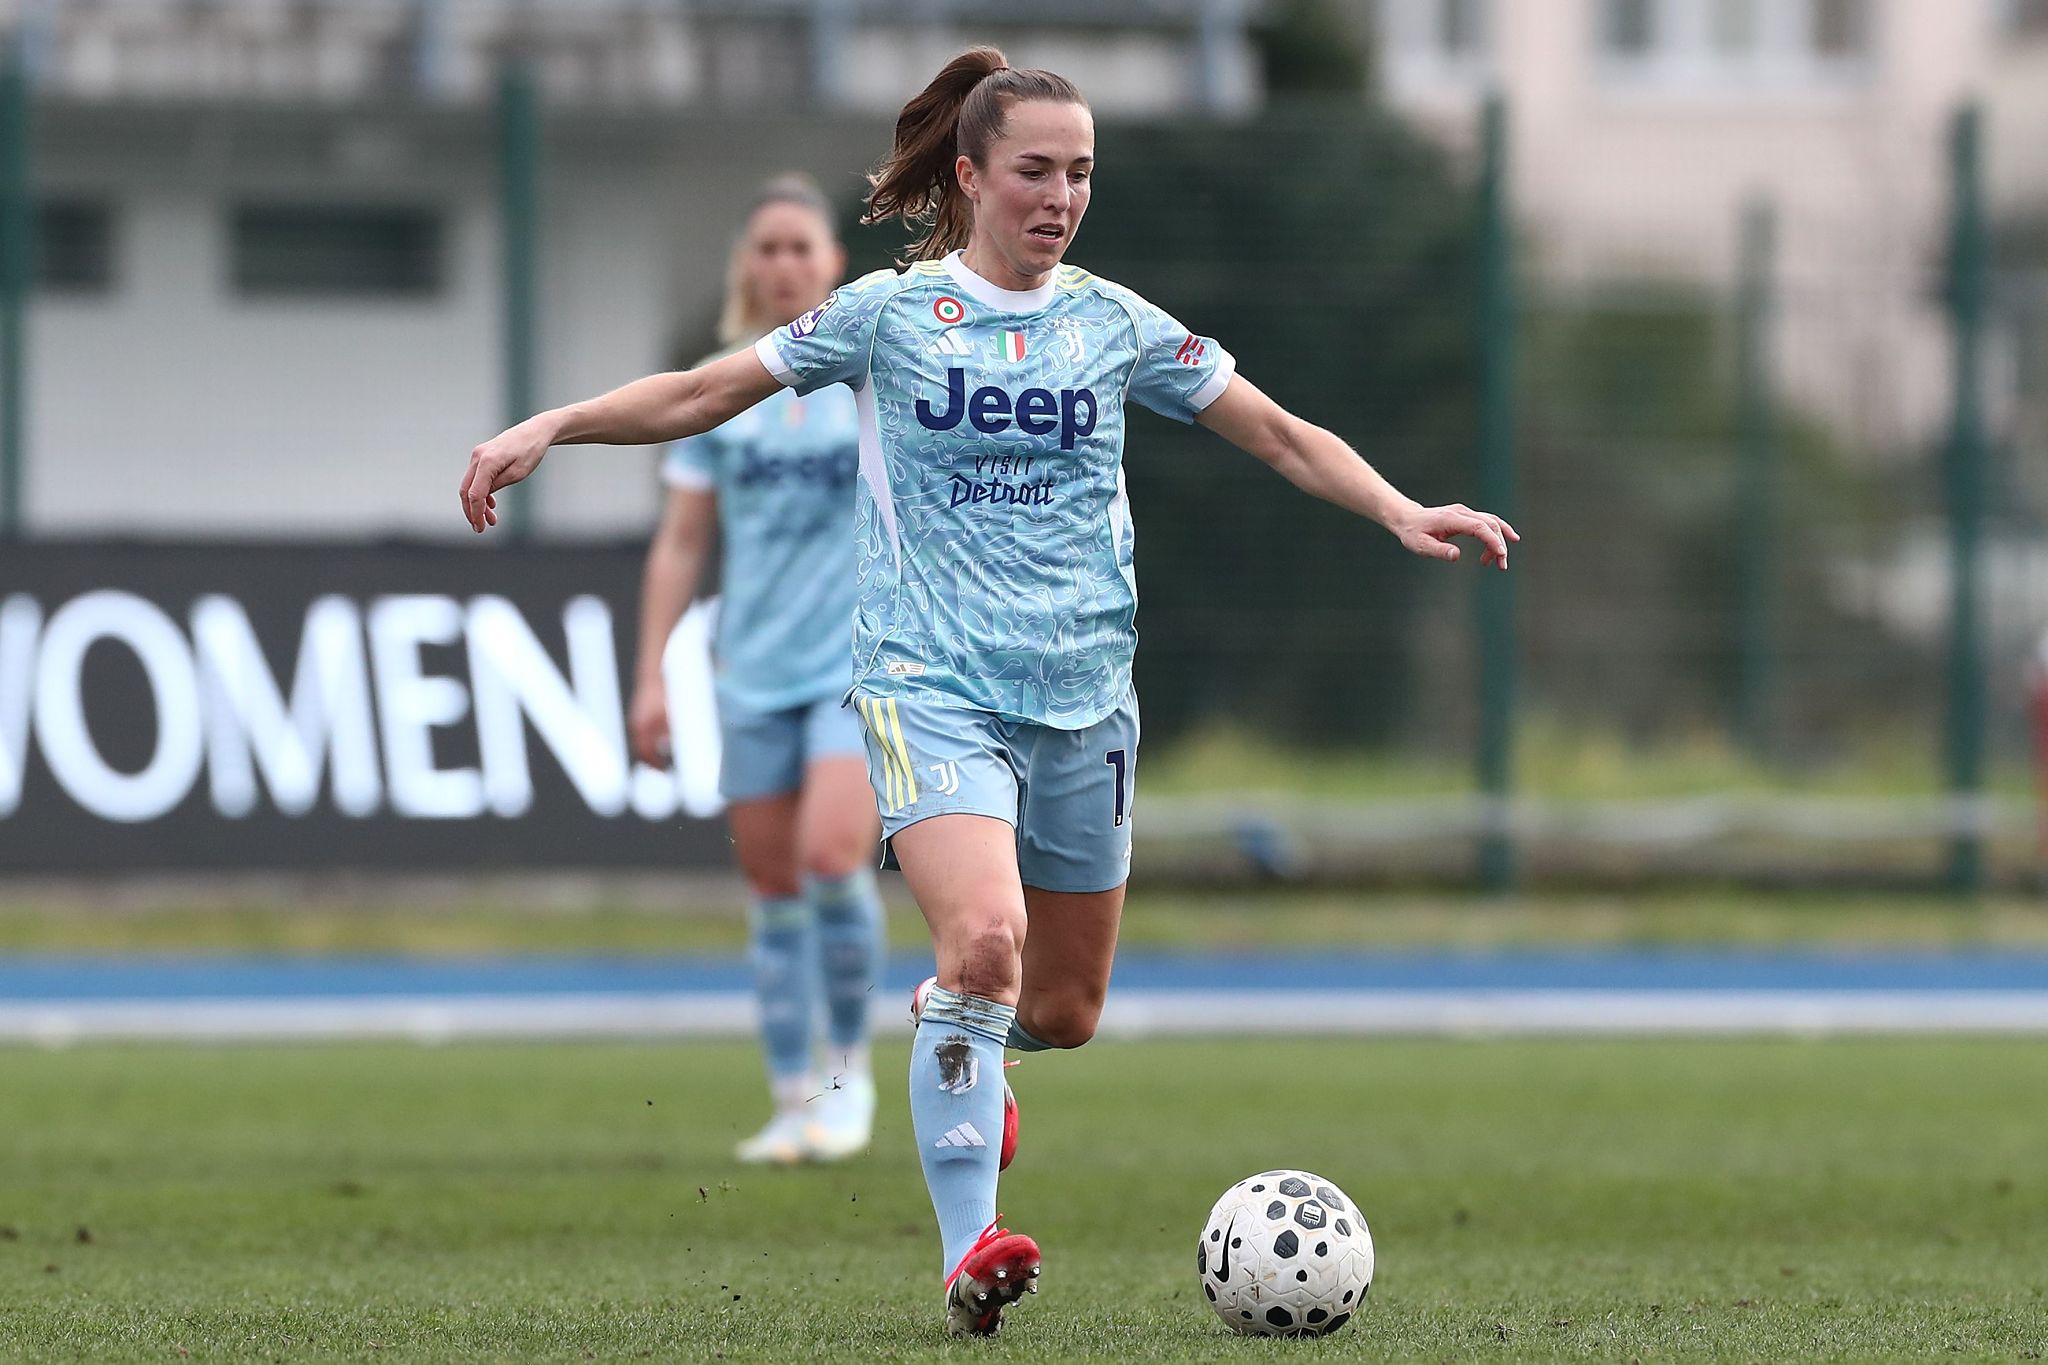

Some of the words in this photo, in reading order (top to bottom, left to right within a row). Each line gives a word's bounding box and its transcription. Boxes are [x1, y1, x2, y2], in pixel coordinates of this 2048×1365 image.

[915, 367, 1098, 450] Jeep
[975, 454, 1034, 476] VISIT
[948, 472, 1055, 509] Detroit
